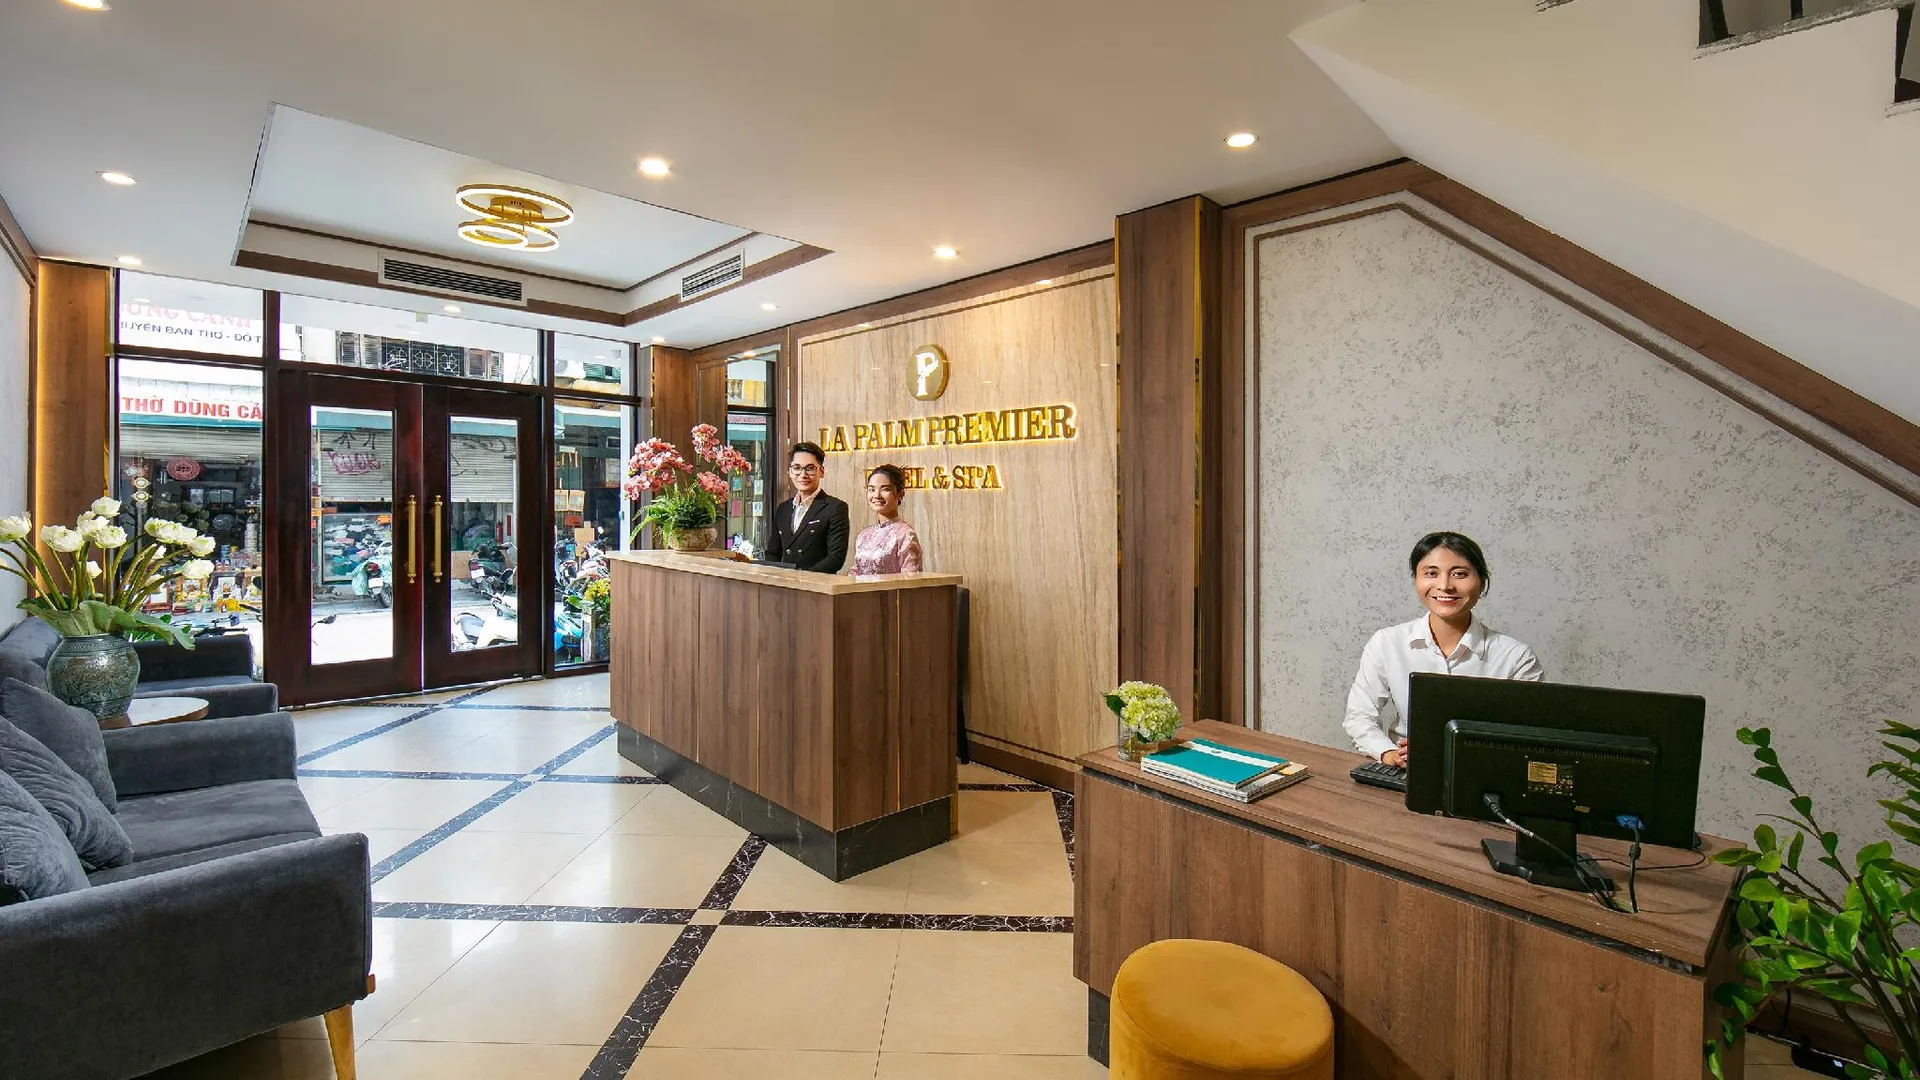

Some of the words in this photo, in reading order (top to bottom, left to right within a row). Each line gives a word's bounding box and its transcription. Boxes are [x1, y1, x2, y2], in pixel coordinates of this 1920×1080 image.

[818, 426, 850, 452] LA
[853, 418, 924, 450] PALM
[927, 404, 1077, 446] PREMIER
[932, 466, 951, 489] &
[952, 465, 1002, 489] SPA
